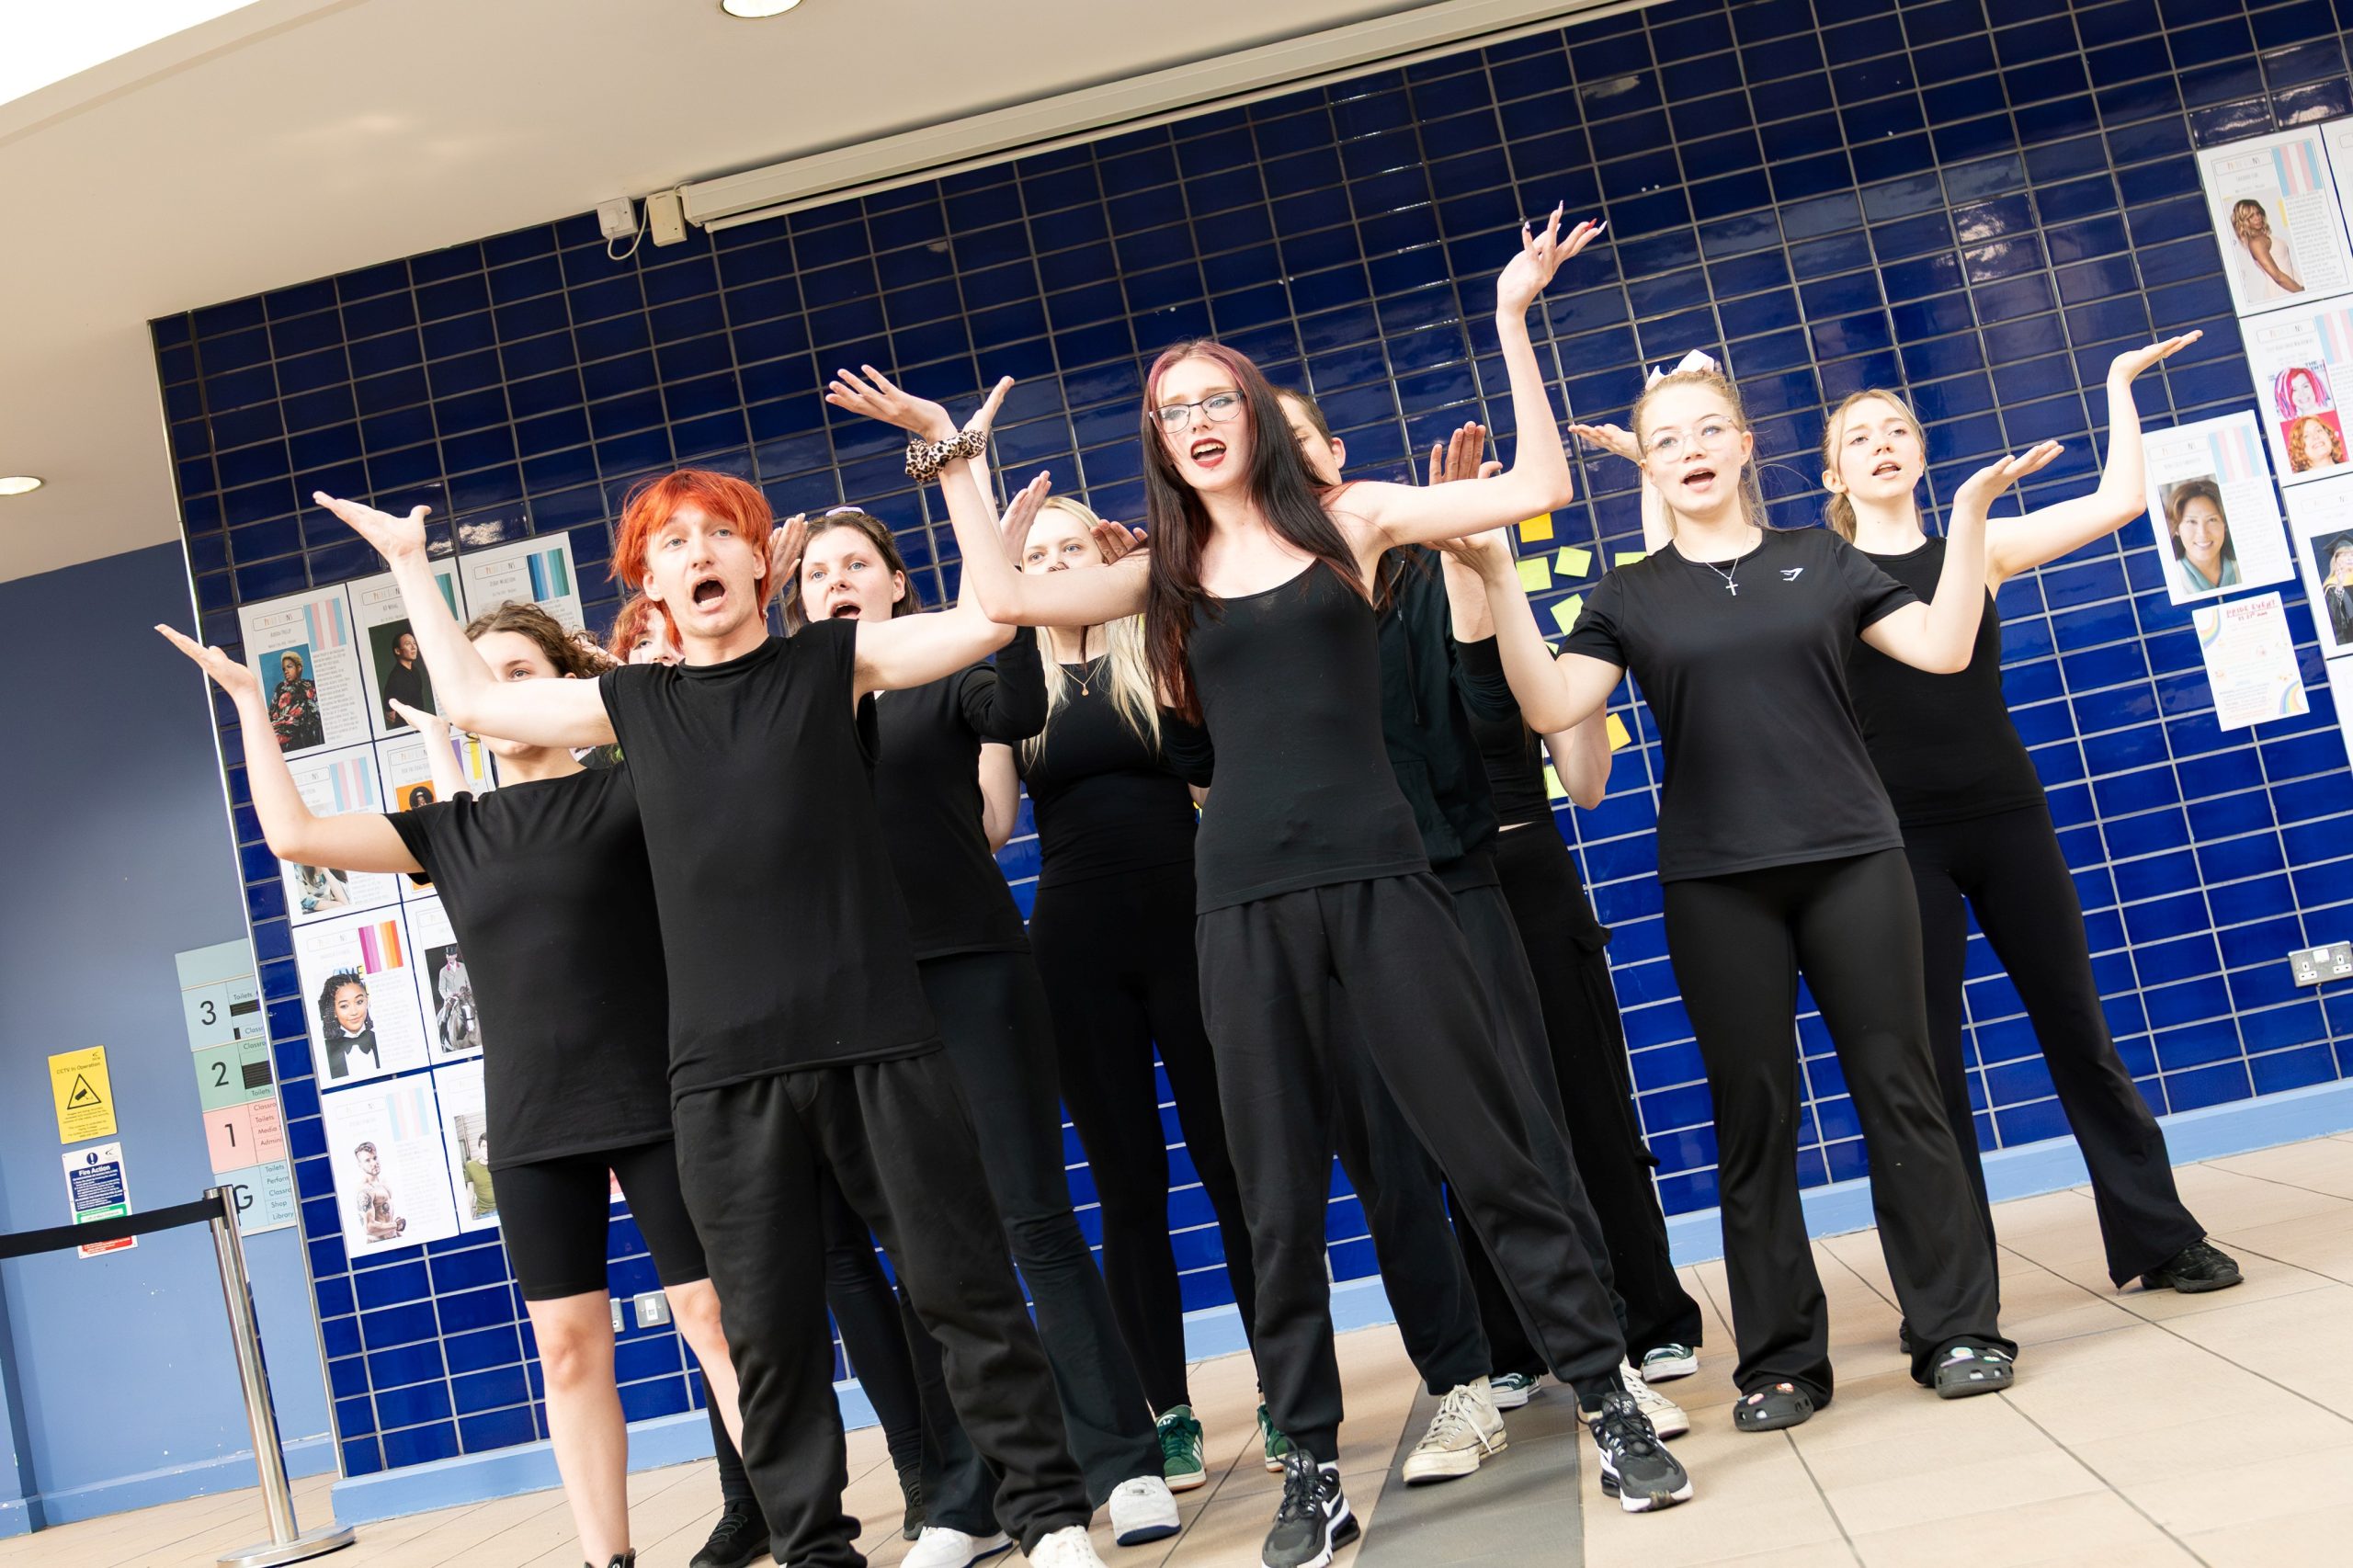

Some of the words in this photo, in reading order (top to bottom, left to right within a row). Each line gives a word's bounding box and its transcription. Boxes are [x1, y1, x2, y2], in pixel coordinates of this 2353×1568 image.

[233, 992, 253, 1001] Toilets
[199, 1000, 217, 1026] 3
[77, 1062, 101, 1071] Operation
[211, 1061, 229, 1088] 2
[251, 1087, 271, 1097] Toilets
[255, 1114, 275, 1124] Toilets
[224, 1123, 236, 1148] 1
[257, 1126, 278, 1135] Media
[78, 1168, 91, 1177] Fire
[91, 1165, 111, 1175] Action
[265, 1164, 285, 1174] Toilets
[233, 1184, 254, 1210] G
[270, 1199, 288, 1210] Shop
[272, 1210, 294, 1221] Library
